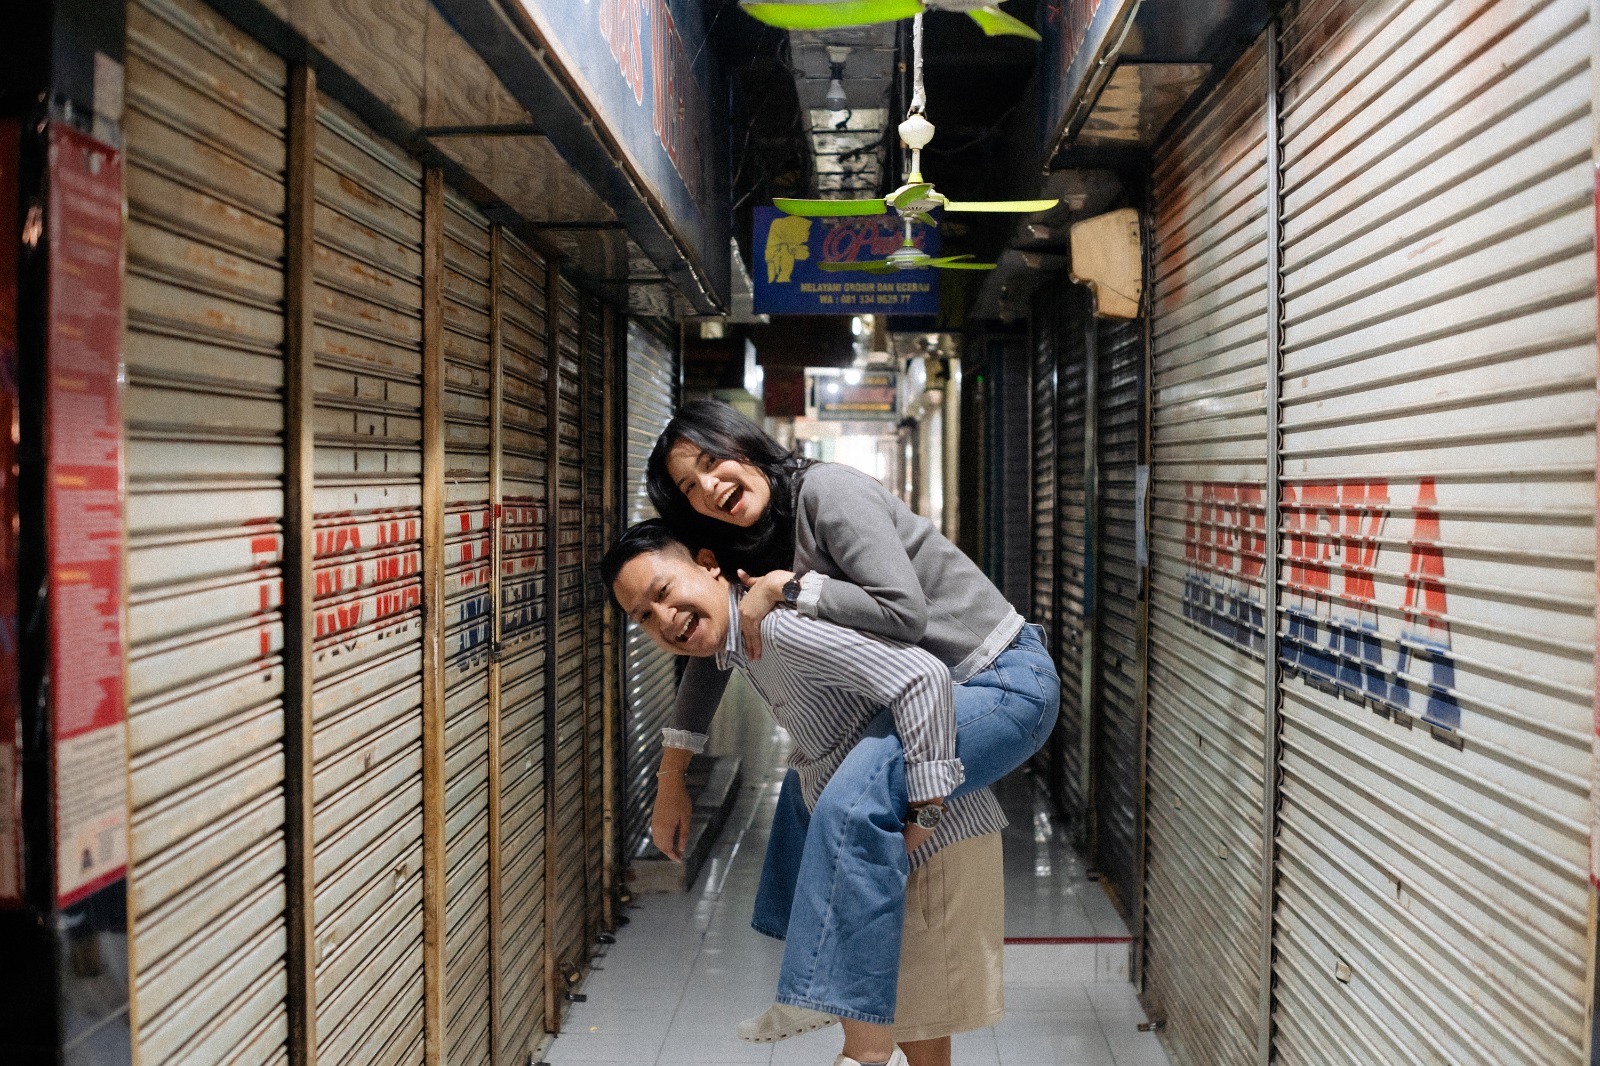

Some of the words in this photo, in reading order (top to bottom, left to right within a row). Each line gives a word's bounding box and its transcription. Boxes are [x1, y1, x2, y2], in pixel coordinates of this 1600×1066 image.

[800, 283, 842, 292] MELAYANI
[843, 283, 875, 292] GROSIR
[877, 283, 894, 292] DAN
[896, 283, 930, 292] ECERAN
[819, 294, 833, 304] WA
[900, 294, 910, 304] 77
